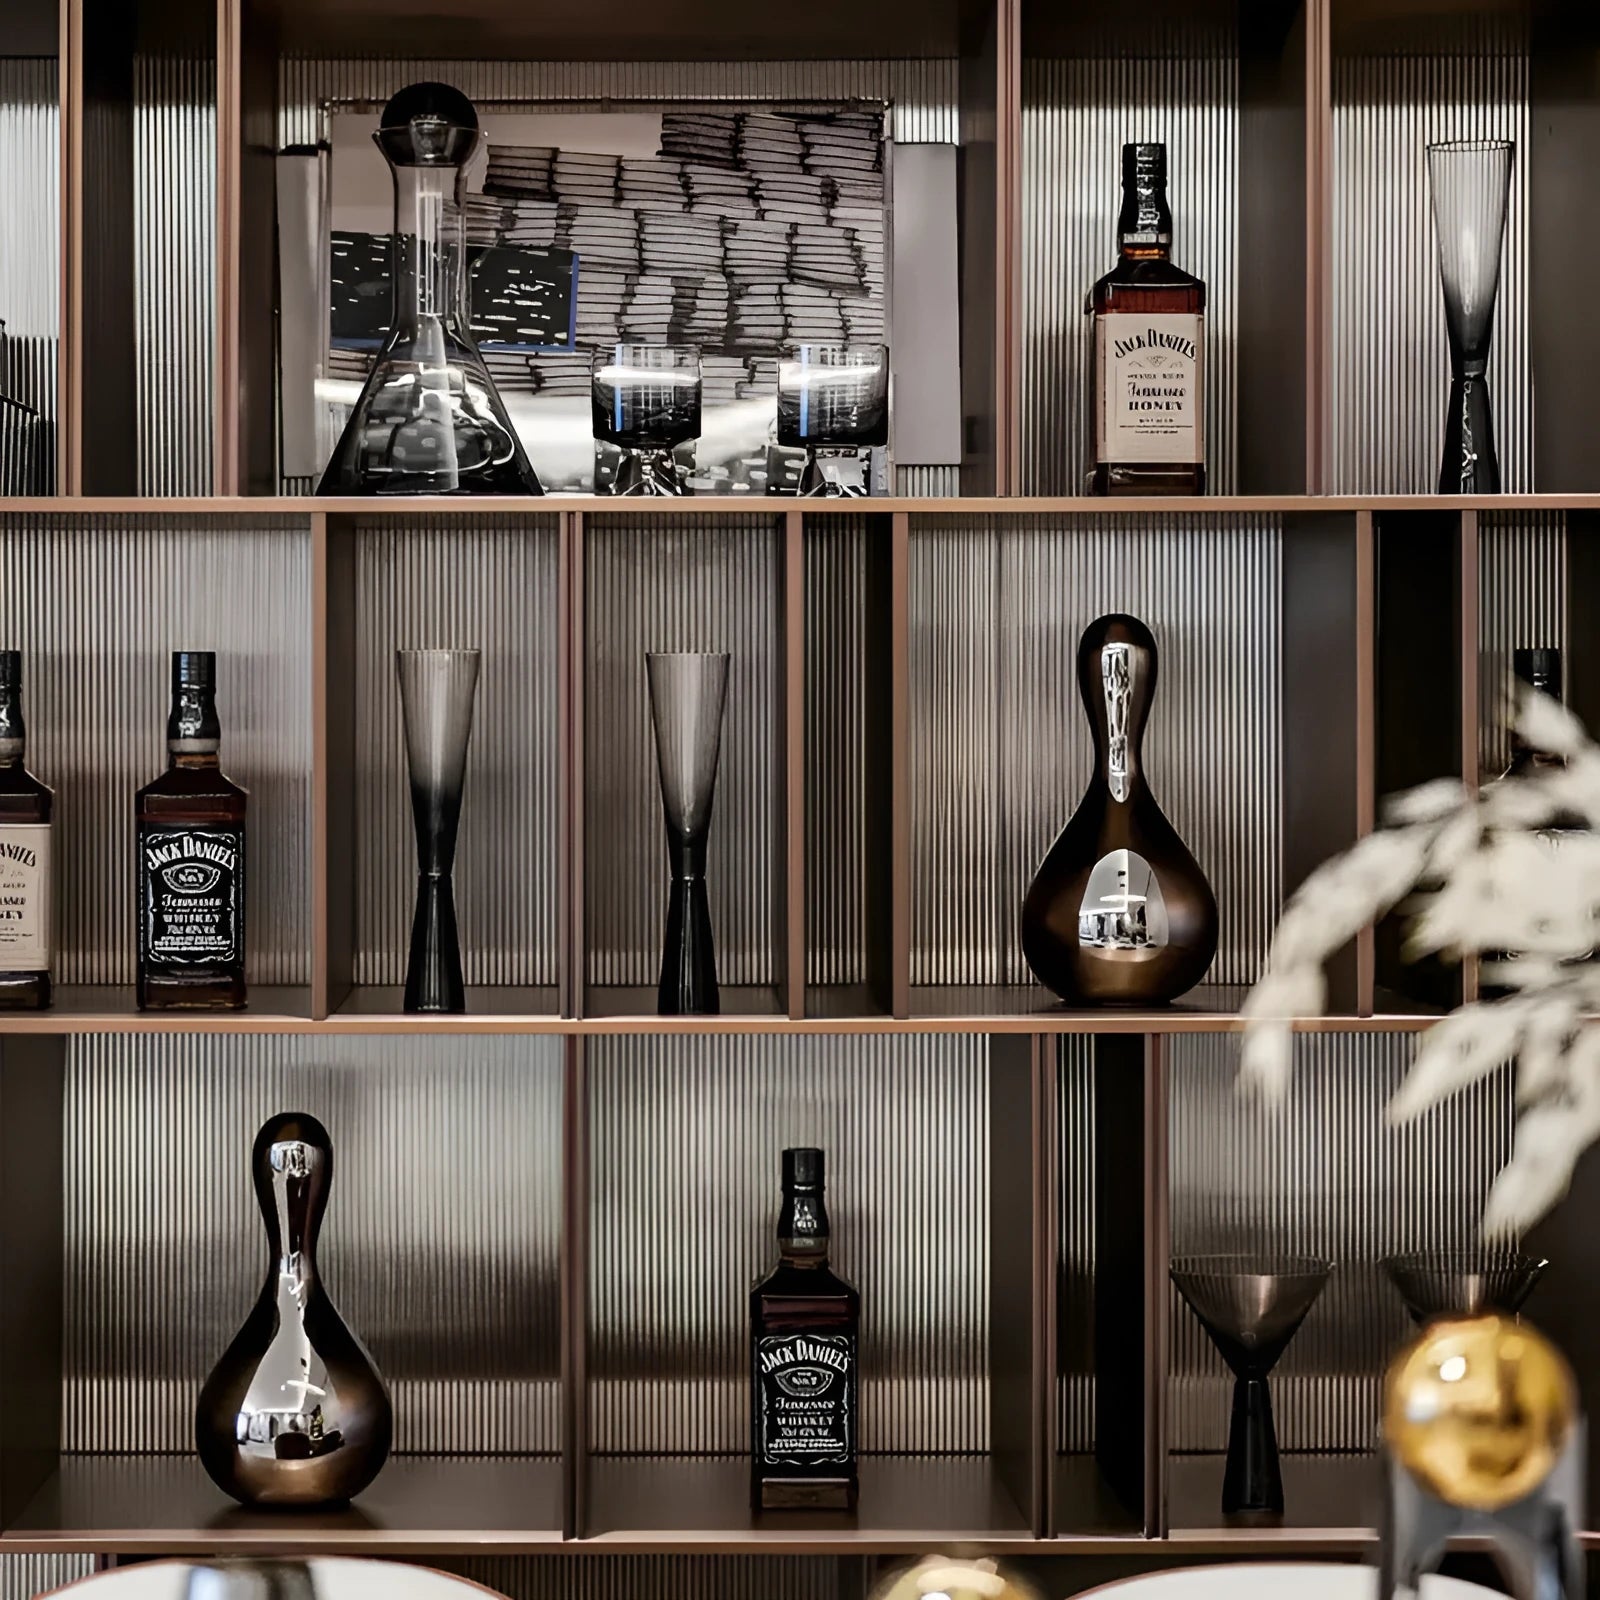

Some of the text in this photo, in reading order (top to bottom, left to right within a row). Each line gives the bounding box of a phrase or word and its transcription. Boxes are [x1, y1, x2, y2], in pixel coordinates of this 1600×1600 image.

[1128, 401, 1183, 411] HONEY
[146, 836, 238, 871] JACK DANIEL'S
[760, 1339, 851, 1373] JACK DANIEL'S
